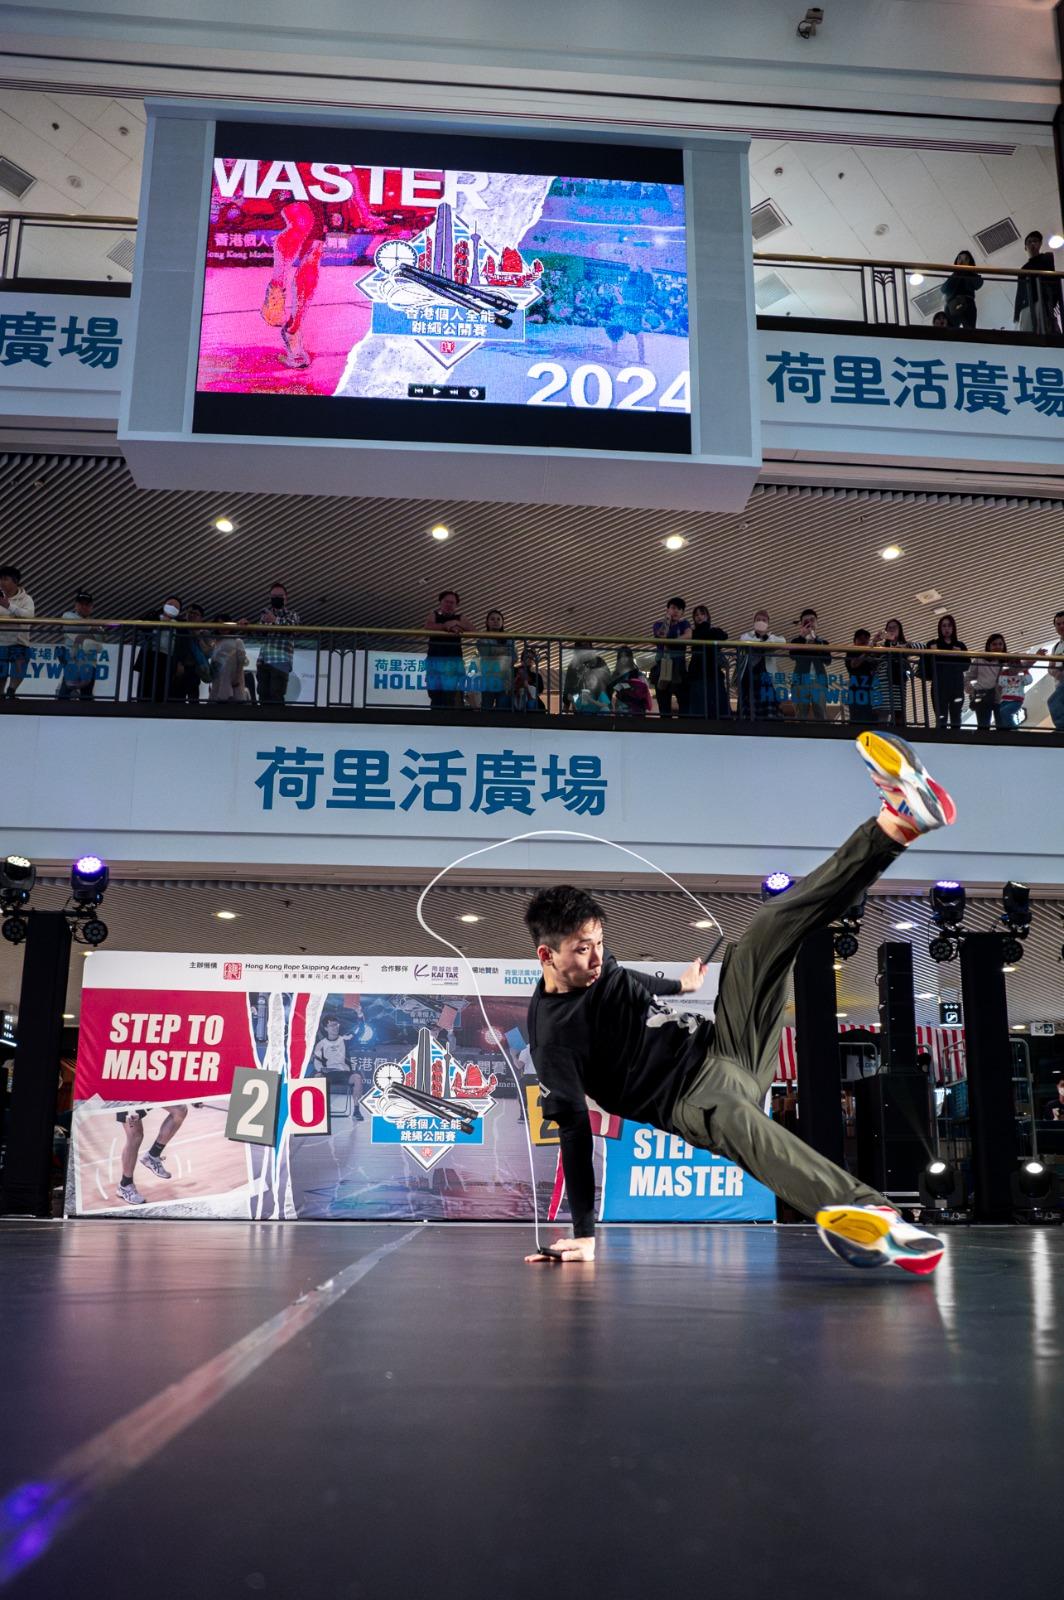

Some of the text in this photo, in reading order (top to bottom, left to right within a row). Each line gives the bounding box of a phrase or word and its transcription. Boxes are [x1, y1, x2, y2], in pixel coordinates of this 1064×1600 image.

[213, 158, 491, 210] MASTER
[405, 307, 495, 324] 香港個人全能
[412, 320, 487, 338] 跳繩公開賽
[0, 311, 122, 369] 廣場
[526, 361, 690, 412] 2024
[766, 350, 1064, 417] 荷里活廣場
[254, 746, 608, 816] 荷里活廣場
[245, 963, 263, 971] Hong
[264, 963, 282, 971] Kong
[283, 963, 301, 971] Rope
[301, 964, 330, 972] Skipping
[330, 964, 361, 972] Academy
[110, 1012, 225, 1046] STEP TO
[102, 1049, 221, 1082] MASTER
[236, 1078, 270, 1138] 2
[395, 1118, 462, 1130] 香港個人全能
[401, 1130, 456, 1142] 跳繩公開賽
[629, 1165, 744, 1197] MASTER
